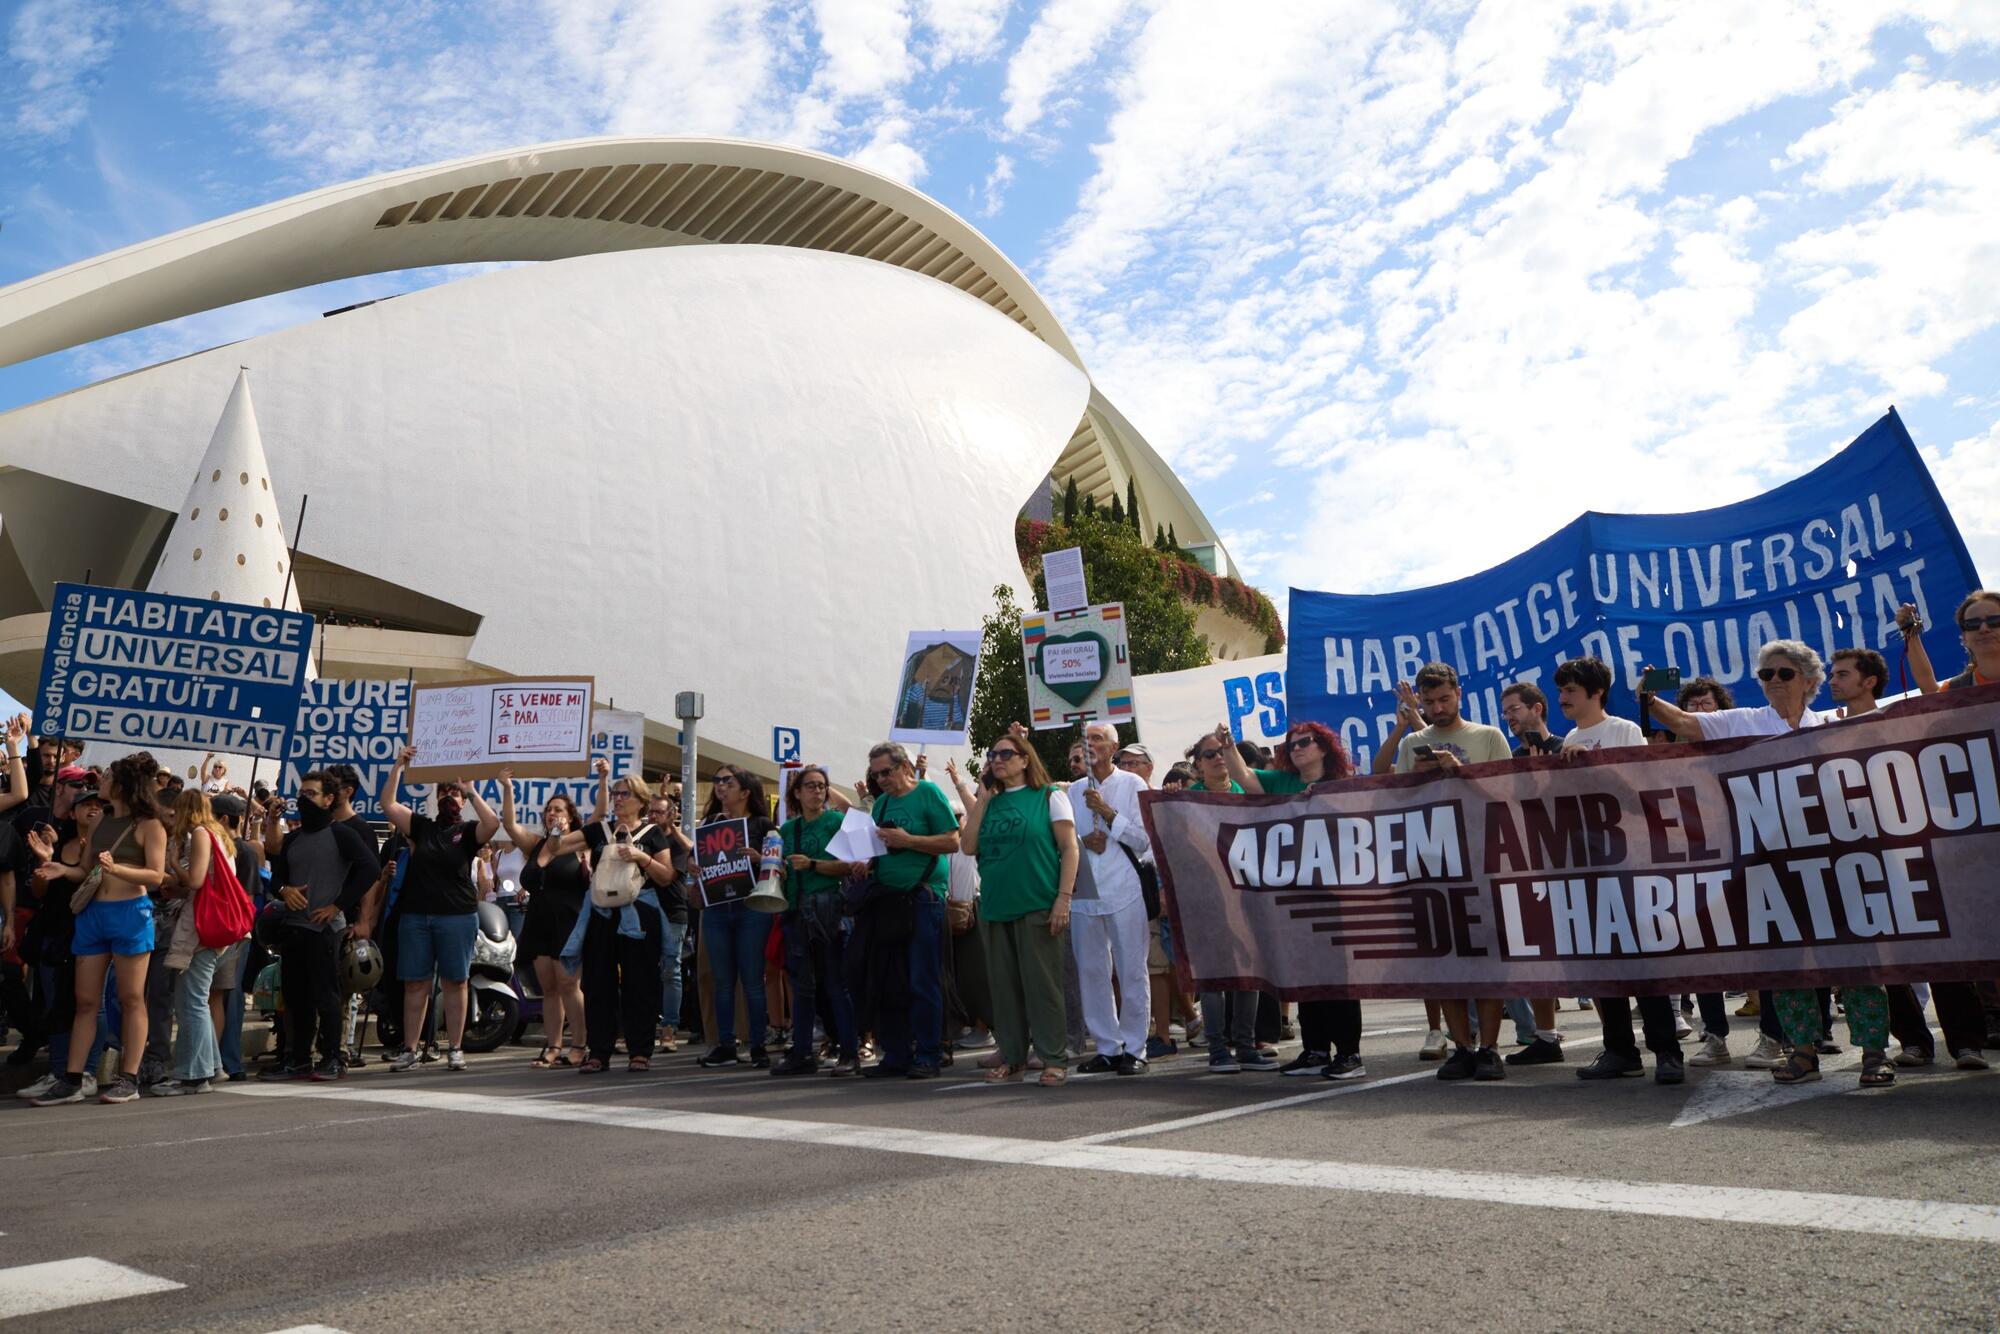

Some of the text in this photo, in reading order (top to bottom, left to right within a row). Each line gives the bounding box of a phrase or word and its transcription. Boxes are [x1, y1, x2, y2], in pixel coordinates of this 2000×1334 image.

[1324, 493, 1913, 695] HABITATGE UNIVERSAL,
[86, 595, 303, 646] HABITATGE
[42, 593, 82, 735] @sdhvalencia
[84, 632, 290, 680] UNIVERSAL
[1062, 658, 1081, 668] 50%
[1580, 625, 1645, 691] DE
[71, 670, 238, 711] GRATUÏT I
[300, 678, 417, 707] ATURE
[498, 692, 581, 709] SE VENDE MI
[1223, 671, 1287, 744] PS
[70, 708, 282, 751] DE QUALITAT
[296, 706, 375, 733] TOTS
[514, 710, 539, 725] PARA
[613, 735, 634, 750] EL
[778, 730, 796, 759] P
[1228, 737, 2000, 888] ACABEM AMB EL NEGOCI
[706, 827, 736, 855] NO
[717, 850, 728, 864] A
[701, 855, 749, 881] L'ESPECULACIÓ
[1408, 846, 1941, 959] DE L'HABITATGE
